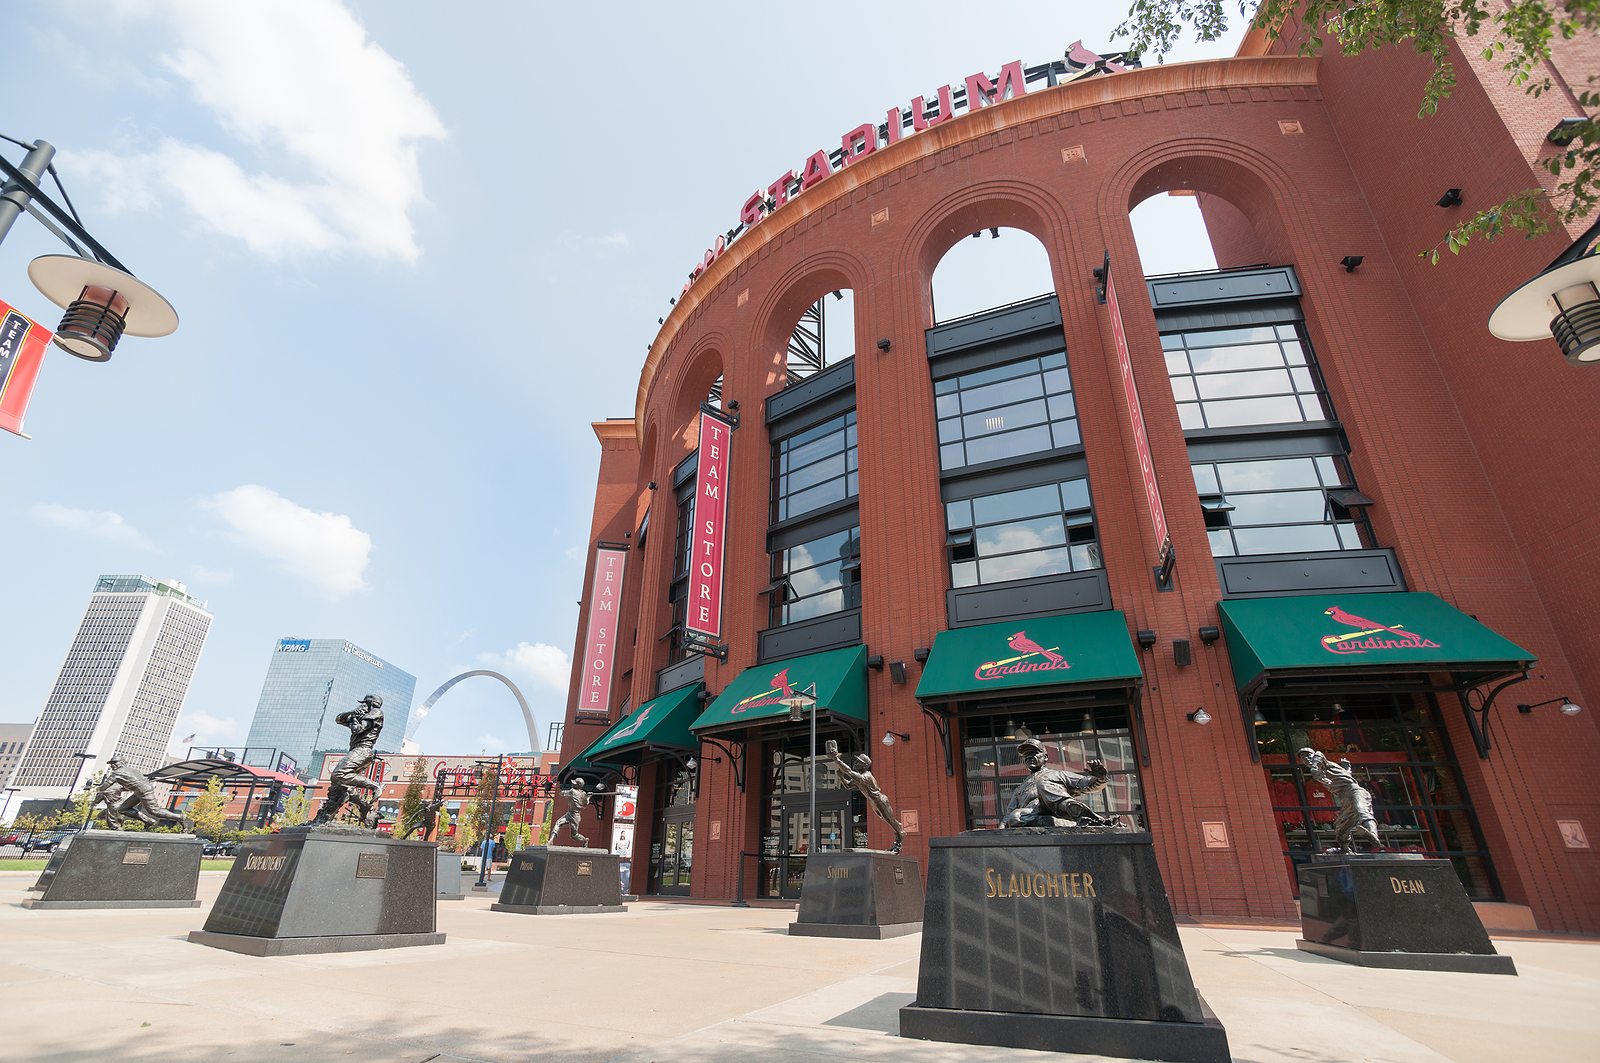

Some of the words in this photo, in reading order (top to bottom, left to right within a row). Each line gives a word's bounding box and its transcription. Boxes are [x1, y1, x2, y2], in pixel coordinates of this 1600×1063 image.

[740, 59, 1028, 231] STADIUM
[0, 320, 22, 359] TEAM
[704, 425, 722, 500] TEAM
[600, 557, 616, 611] TEAM
[698, 520, 715, 623] STORE
[277, 644, 308, 653] KPMG
[1320, 634, 1441, 655] Cardinals
[591, 628, 606, 703] STORE
[974, 660, 1072, 681] Cardinals
[827, 865, 849, 879] SMITH
[985, 867, 1097, 898] SLAUGHTER
[1389, 876, 1426, 894] DEAN
